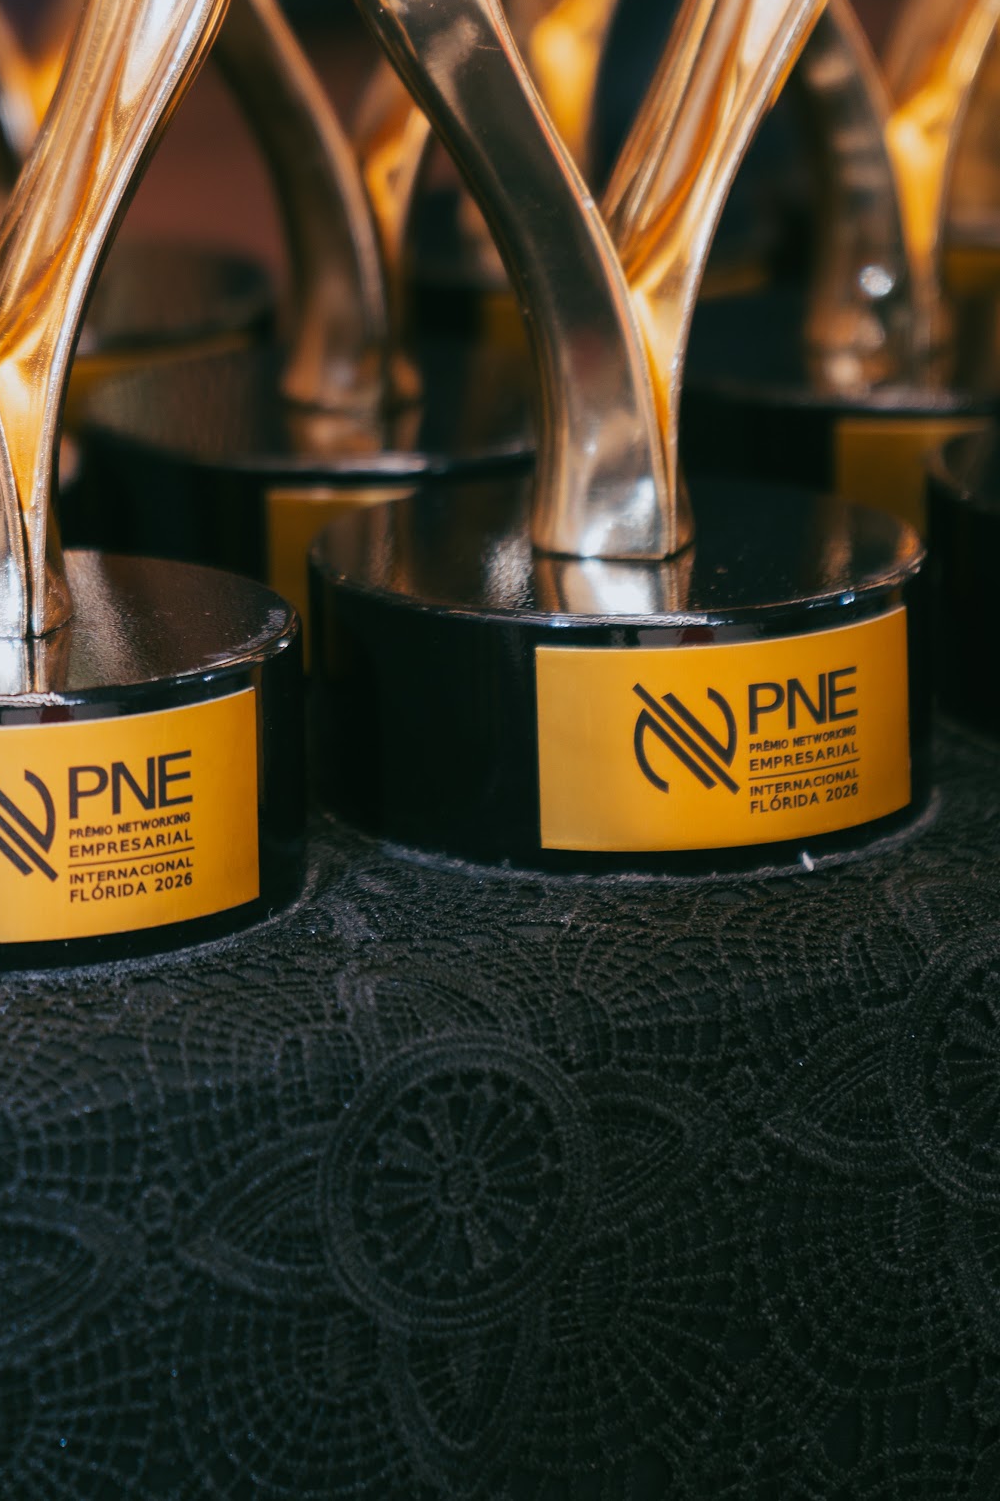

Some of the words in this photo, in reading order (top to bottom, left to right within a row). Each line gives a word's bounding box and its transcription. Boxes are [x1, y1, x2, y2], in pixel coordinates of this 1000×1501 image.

[748, 666, 858, 735] PNE
[749, 739, 789, 753] PRÊMIO
[793, 725, 857, 748] NETWORKING
[749, 742, 859, 771] EMPRESARIAL
[68, 749, 193, 820] PNE
[750, 768, 859, 796] INTERNACIONAL
[750, 792, 820, 814] FLÓRIDA
[825, 782, 859, 802] 2026
[69, 825, 113, 840] PRÊMIO
[117, 812, 191, 834] NETWORKING
[69, 829, 193, 858] EMPRESARIAL
[69, 857, 194, 885] INTERNACIONAL
[70, 881, 147, 903] FLÓRIDA
[154, 872, 193, 892] 2026
